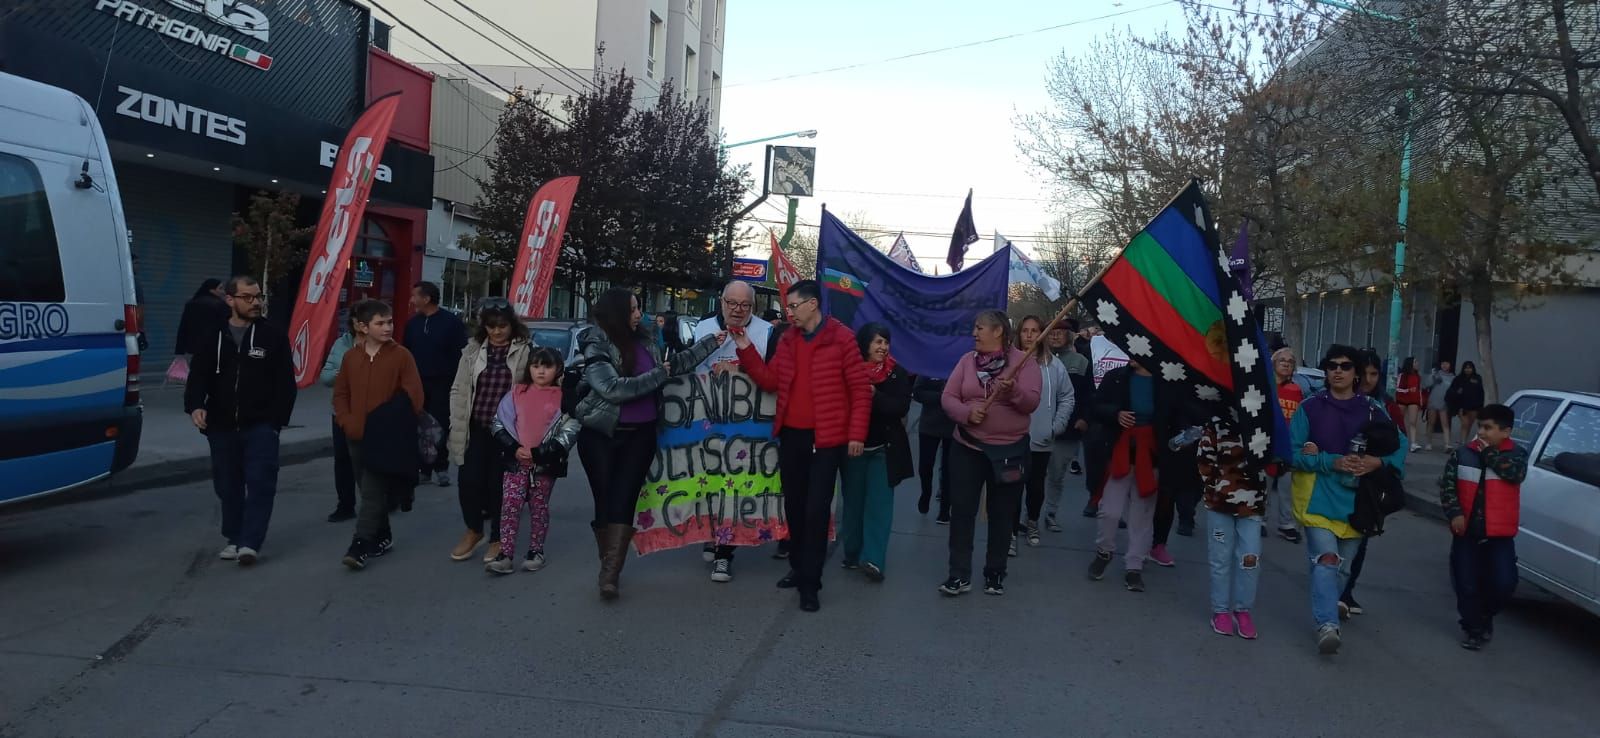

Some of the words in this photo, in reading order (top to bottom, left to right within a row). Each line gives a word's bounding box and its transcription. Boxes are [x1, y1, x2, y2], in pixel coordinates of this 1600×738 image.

[95, 0, 232, 56] PATAGONIA
[116, 86, 247, 146] ZONTES
[306, 136, 372, 303] Beta
[514, 199, 556, 317] Beta
